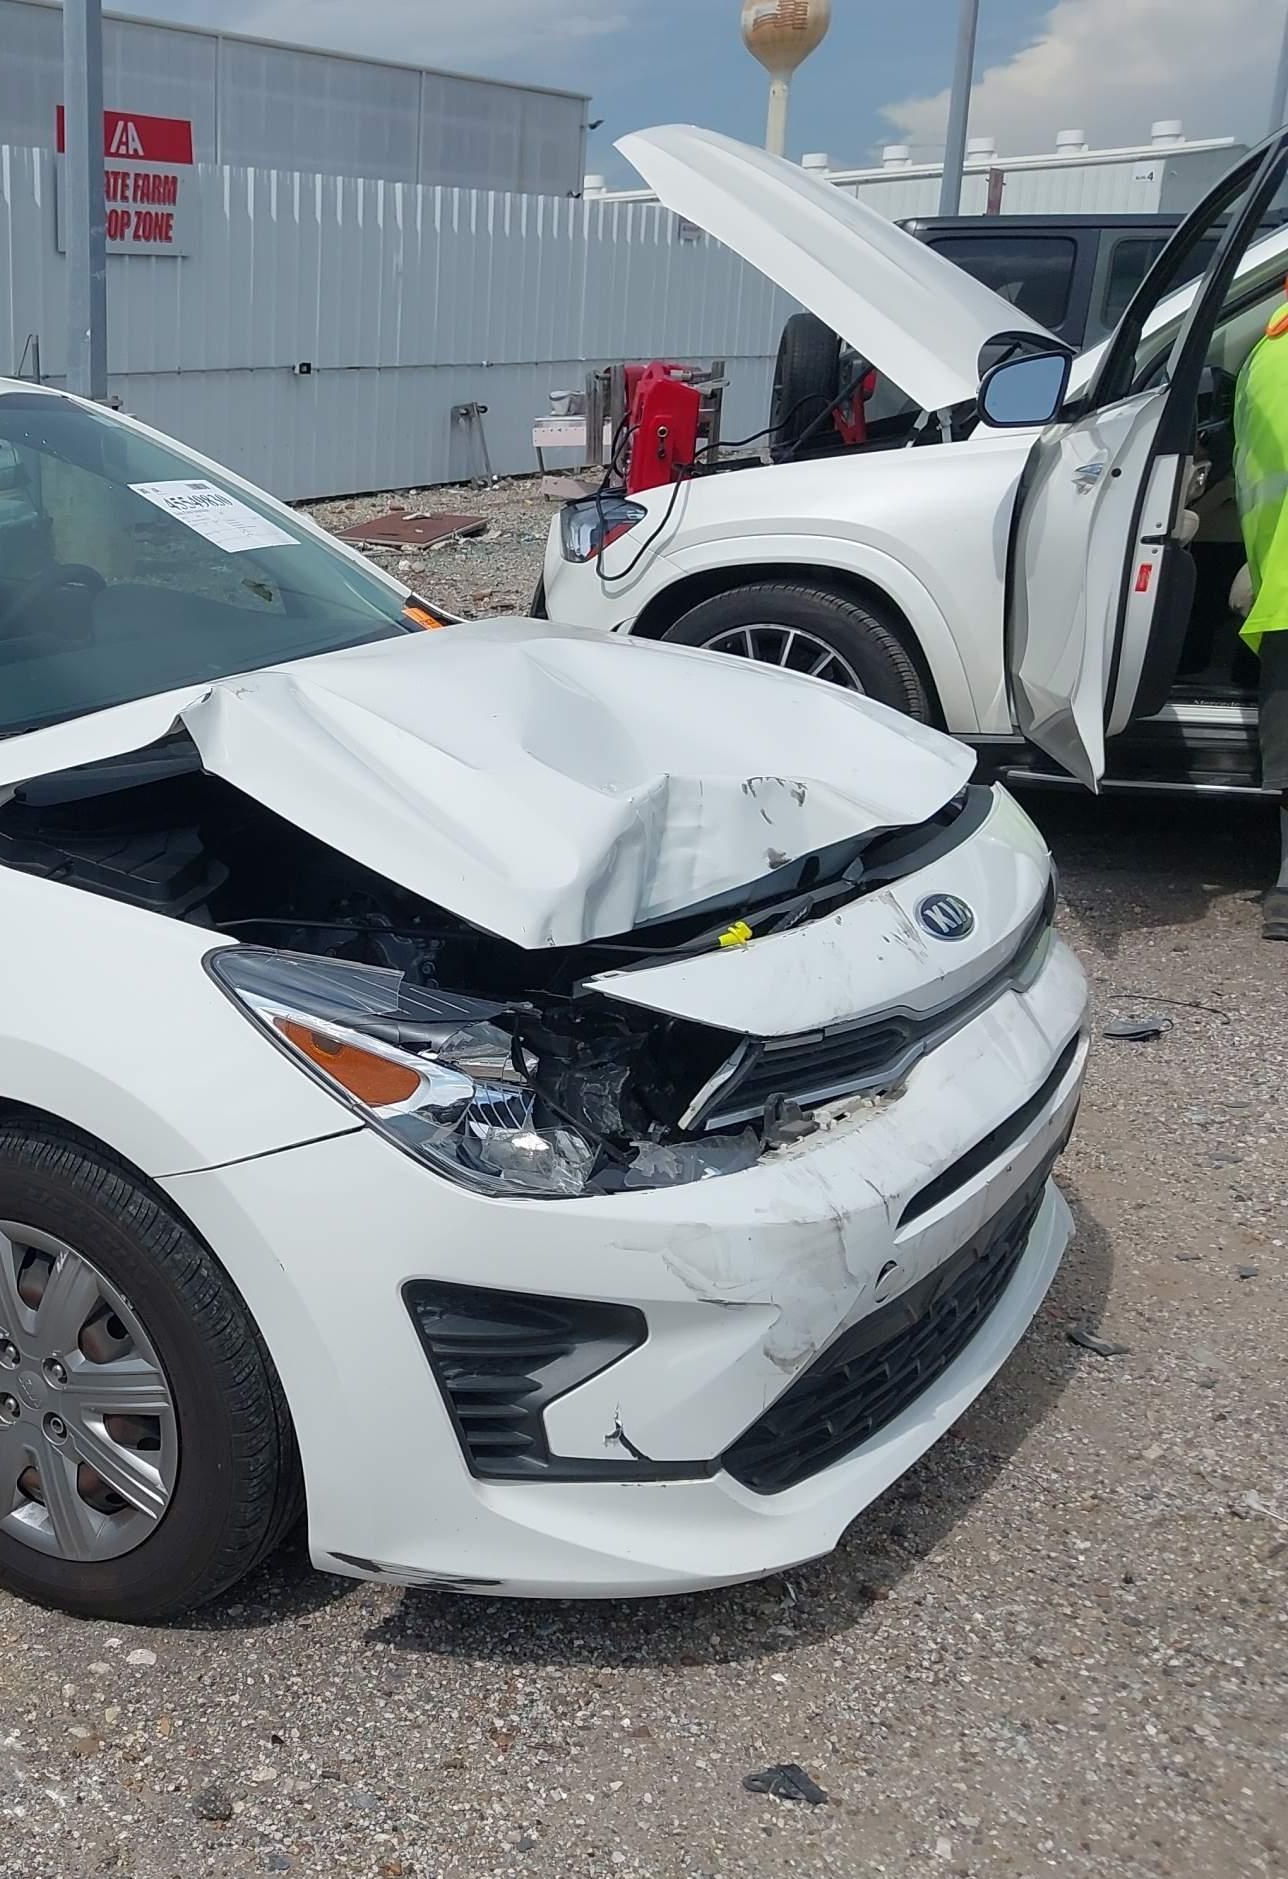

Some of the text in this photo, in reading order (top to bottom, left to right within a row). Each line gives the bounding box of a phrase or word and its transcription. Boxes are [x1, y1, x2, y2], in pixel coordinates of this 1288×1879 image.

[132, 172, 178, 207] FARM
[106, 208, 174, 244] OP ZONE
